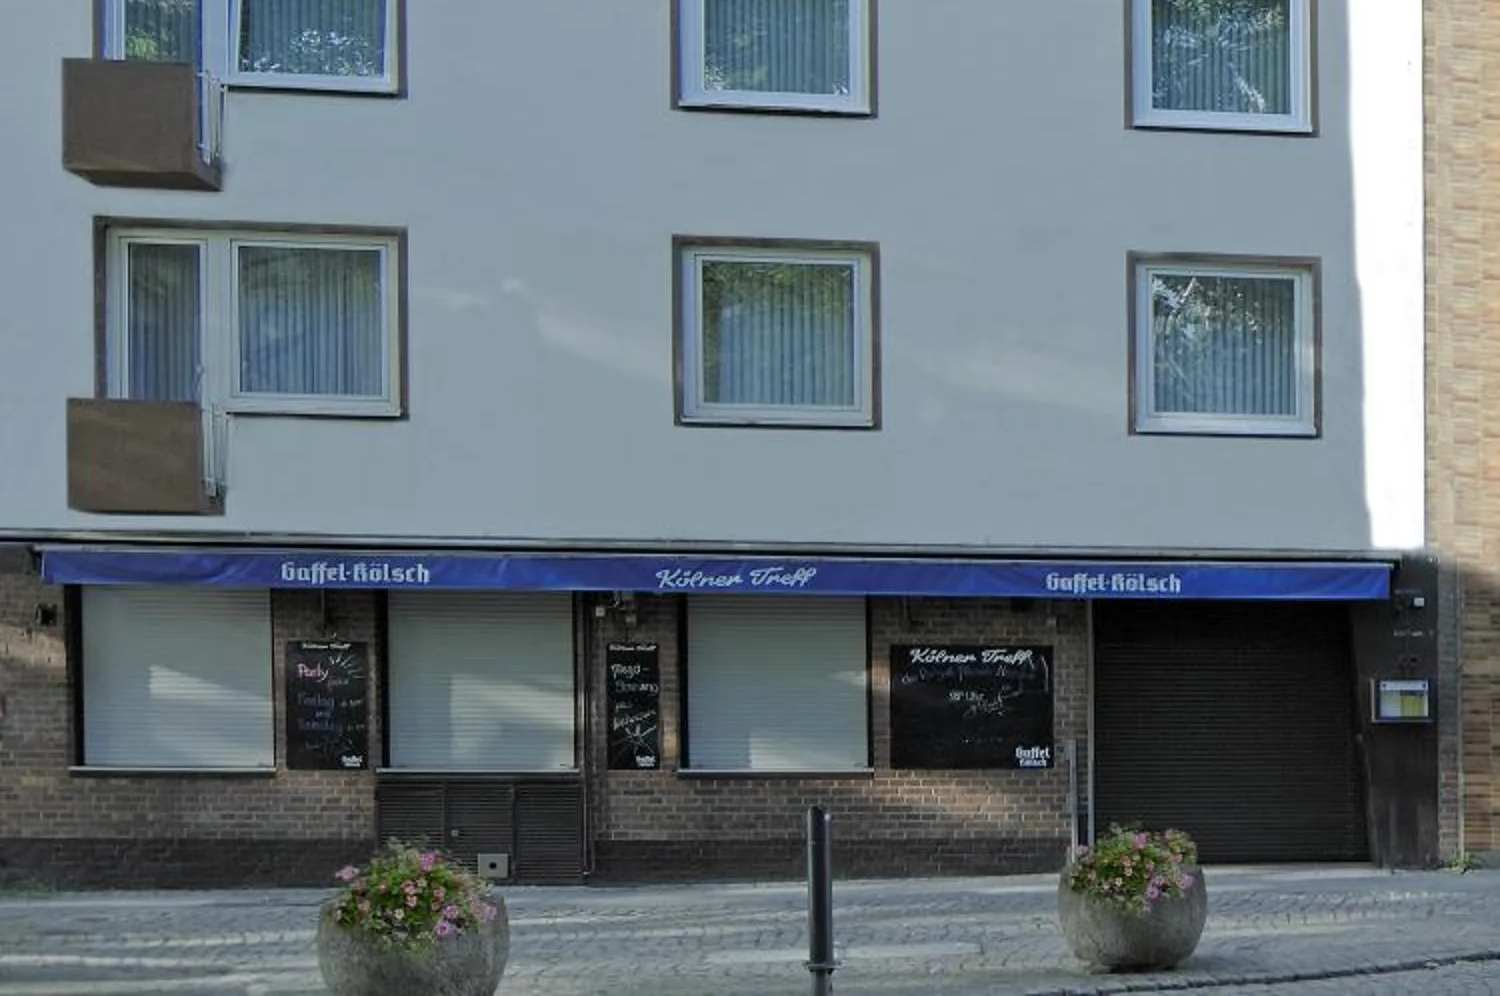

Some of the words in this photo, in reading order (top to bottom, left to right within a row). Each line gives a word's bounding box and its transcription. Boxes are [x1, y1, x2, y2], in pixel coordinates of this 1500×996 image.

[655, 567, 745, 589] Kölner
[749, 566, 817, 588] Treff
[909, 648, 977, 664] Kölner
[980, 649, 1033, 665] Treff
